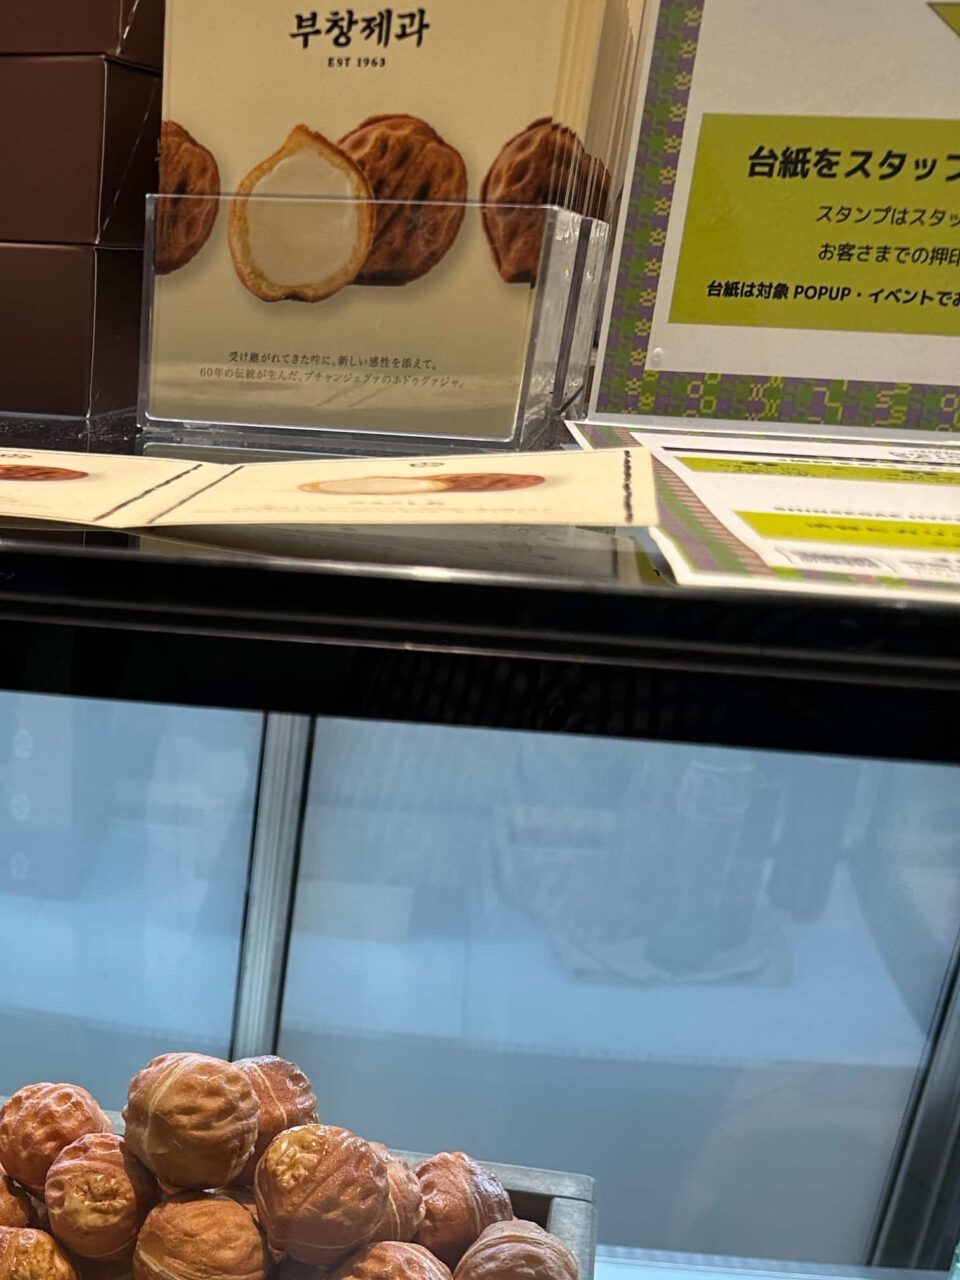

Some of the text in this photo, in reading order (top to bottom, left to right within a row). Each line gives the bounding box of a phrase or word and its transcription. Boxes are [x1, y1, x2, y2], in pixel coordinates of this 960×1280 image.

[290, 7, 430, 49] 부창제과
[328, 57, 386, 68] EST 1963
